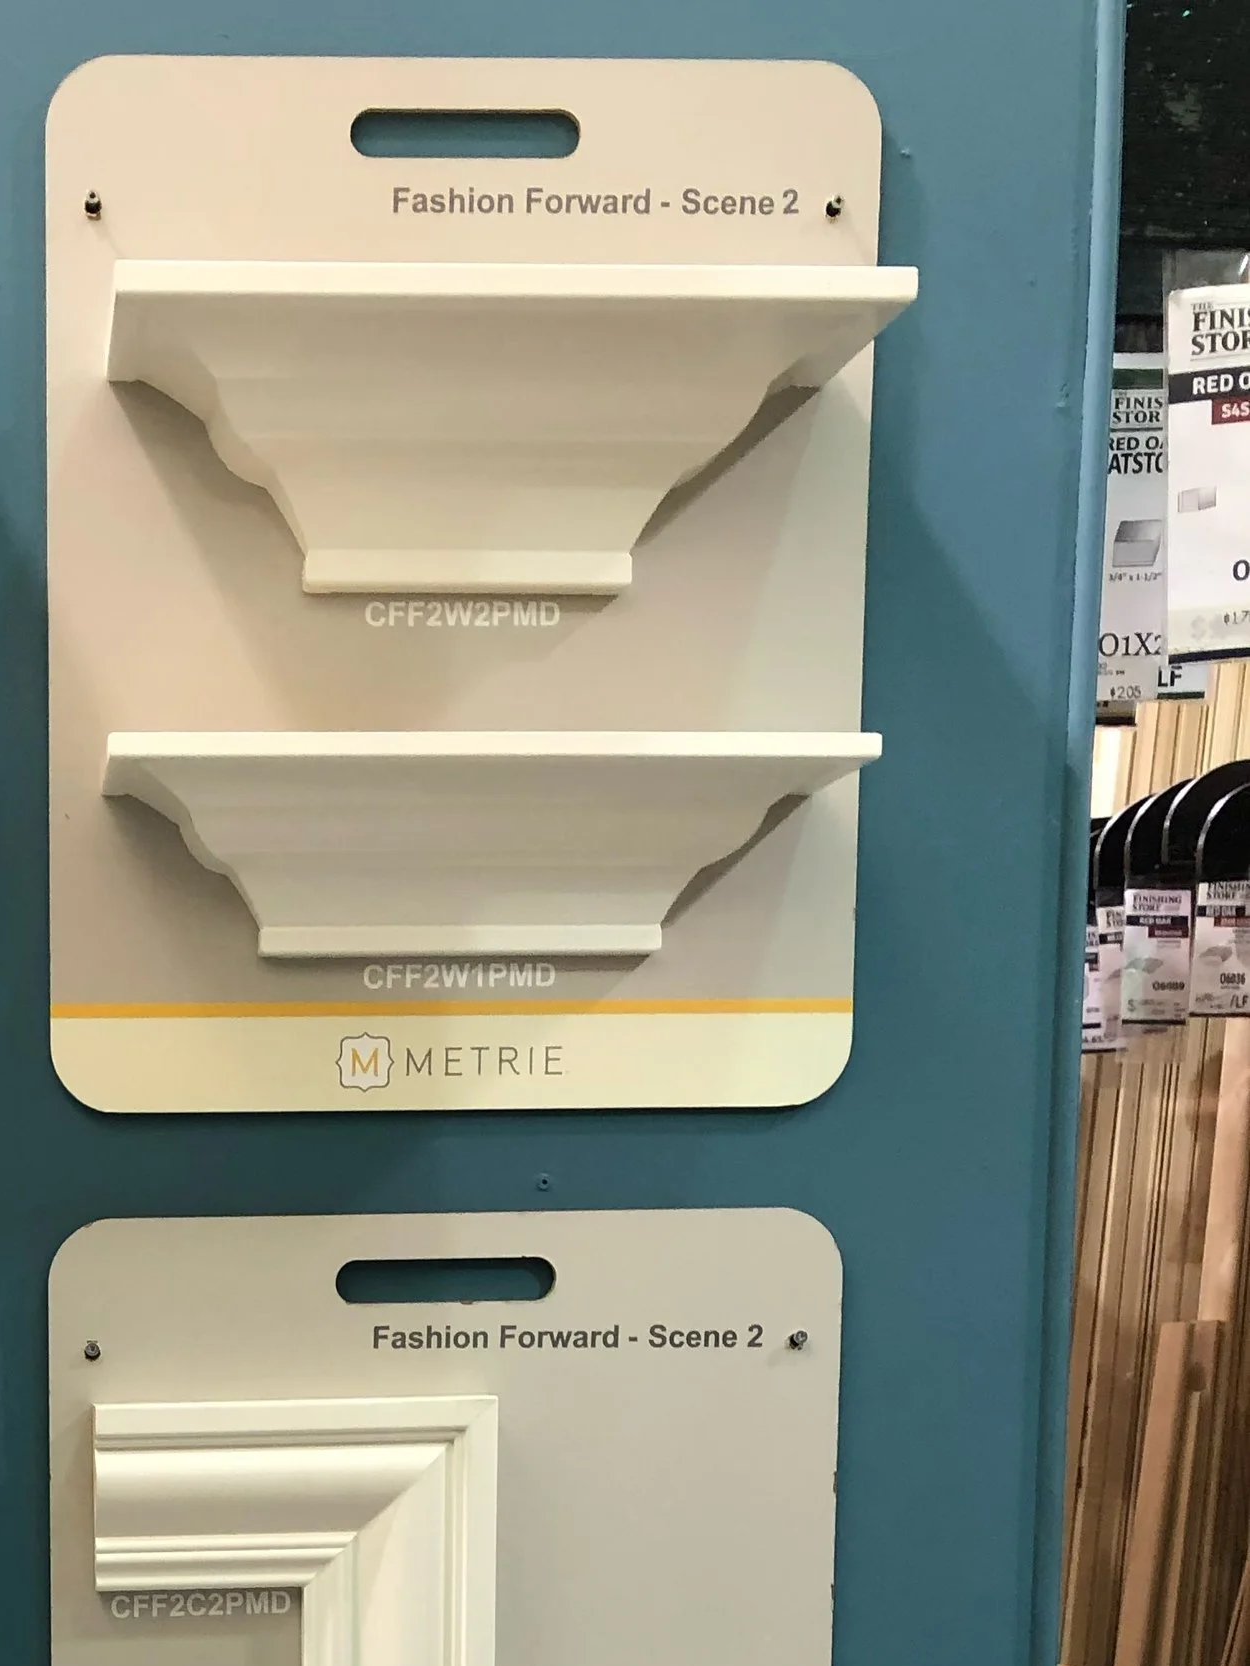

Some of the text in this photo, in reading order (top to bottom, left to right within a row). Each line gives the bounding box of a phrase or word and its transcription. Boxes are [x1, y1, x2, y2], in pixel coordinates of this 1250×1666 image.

[391, 187, 514, 215] Fashion
[526, 187, 652, 215] Forward
[681, 189, 775, 215] Scene
[783, 188, 800, 215] 2
[1193, 309, 1250, 332] FINI
[1192, 374, 1234, 395] RED
[364, 601, 561, 628] CFF2W2PMD
[362, 962, 555, 990] CFF2W1PMD
[350, 1045, 565, 1077] M METRIE
[372, 1325, 489, 1350] Fashion
[499, 1324, 620, 1349] Forward
[648, 1323, 738, 1349] Scene
[747, 1323, 764, 1348] 2
[110, 1590, 291, 1619] CFF2C2PMD
